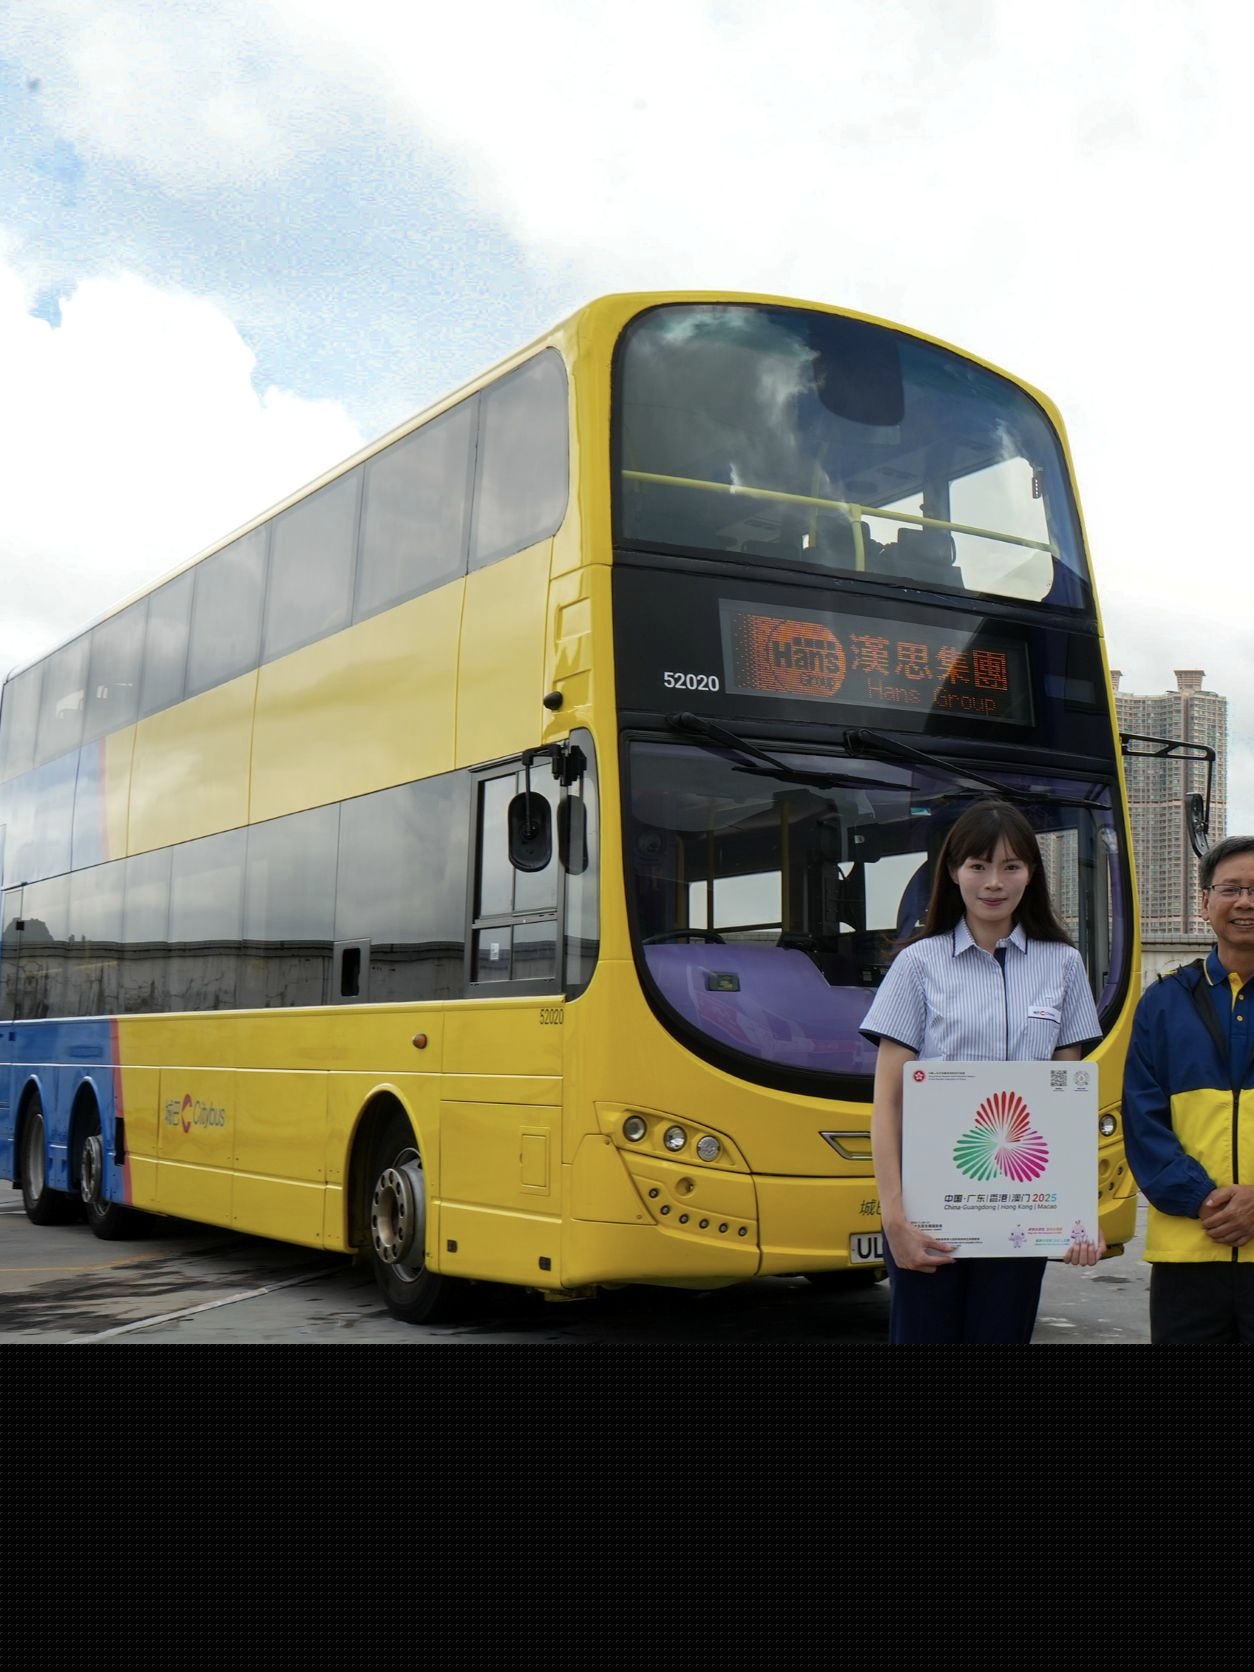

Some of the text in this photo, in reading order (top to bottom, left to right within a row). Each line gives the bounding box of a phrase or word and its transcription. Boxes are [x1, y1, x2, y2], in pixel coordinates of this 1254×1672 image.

[773, 638, 840, 674] Hans
[850, 633, 1007, 691] 漢思集團
[663, 672, 719, 692] 52020
[867, 678, 921, 705] Hans
[933, 685, 997, 716] Group
[540, 1008, 564, 1025] 52020
[193, 1100, 225, 1128] Citybus
[1032, 1193, 1057, 1203] 2025
